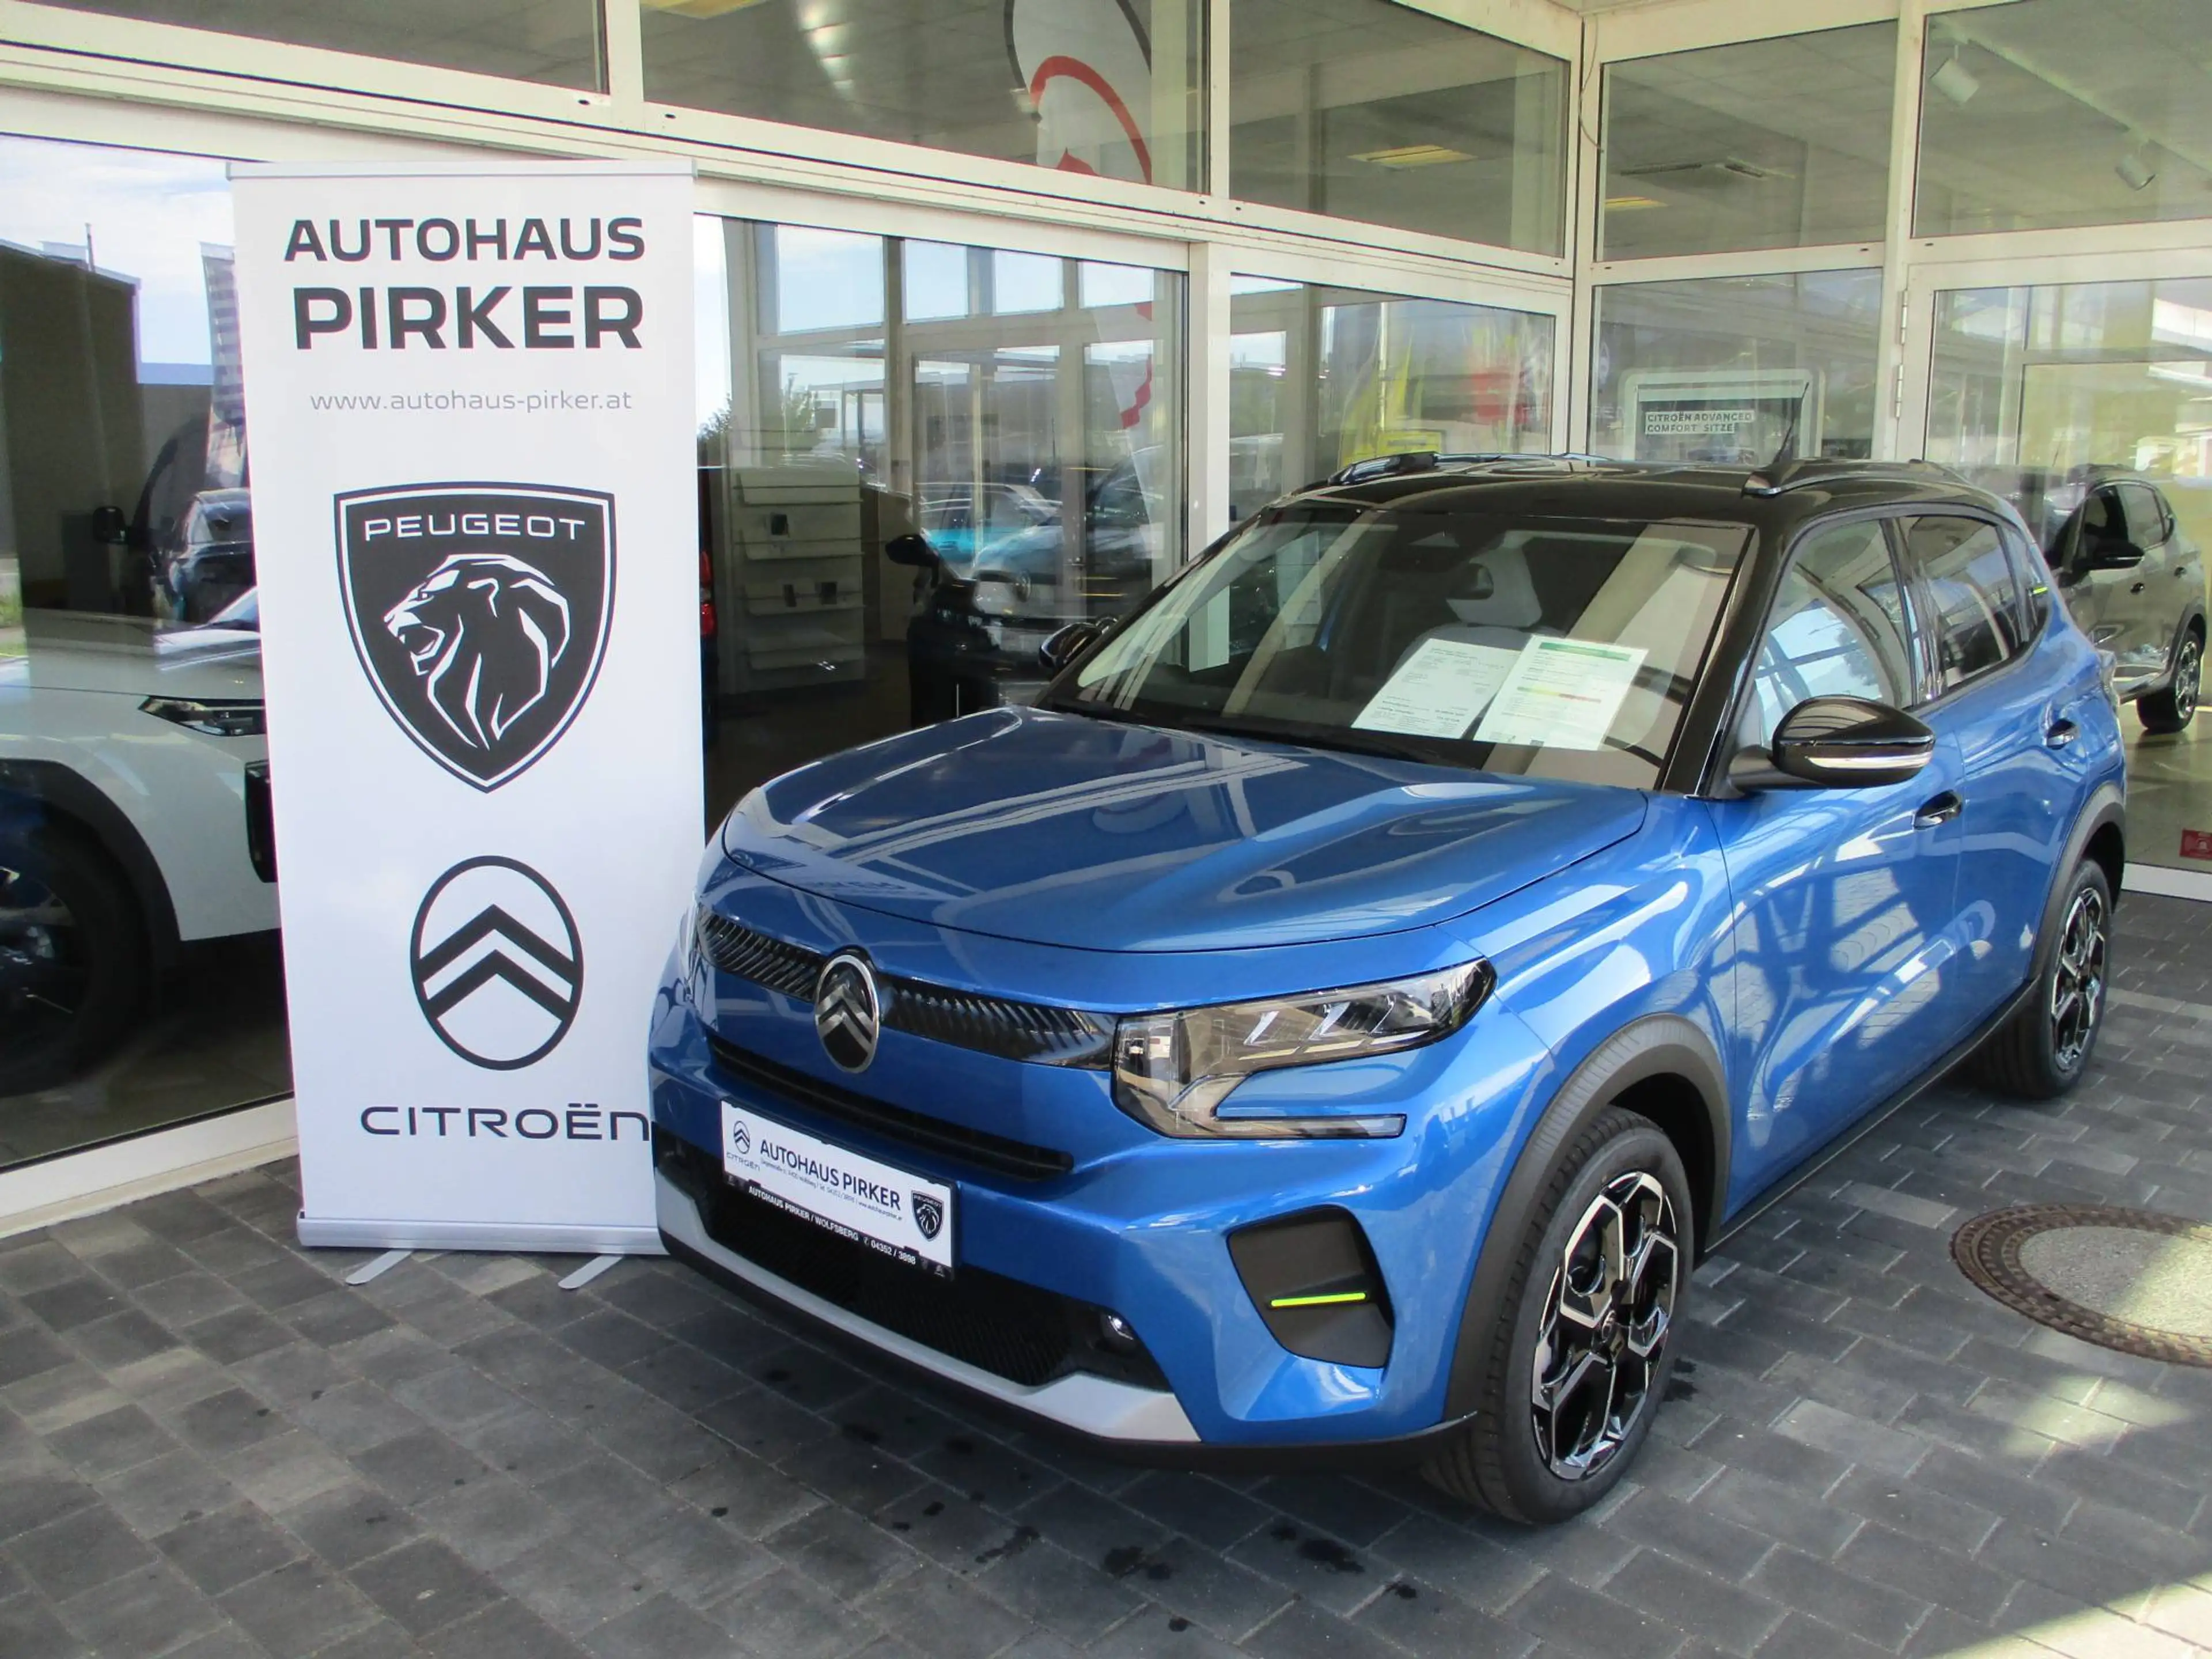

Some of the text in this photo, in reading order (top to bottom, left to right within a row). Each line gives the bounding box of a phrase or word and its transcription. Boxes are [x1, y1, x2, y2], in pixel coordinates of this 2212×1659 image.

[285, 217, 645, 262] AUTOHAUS
[293, 286, 643, 350] PIRKER
[310, 389, 632, 414] www.autohaus-pirker.at
[1694, 412, 1751, 422] ADVANCED
[1647, 424, 1698, 432] COMFORT
[364, 513, 585, 541] PEUGEOT
[361, 1103, 650, 1142] CITROËN
[760, 1139, 839, 1187] AUTOHAUS
[843, 1172, 901, 1211] PIRKER
[748, 1185, 783, 1209] AUTOHAUS
[785, 1202, 810, 1221] PIRKER
[815, 1215, 859, 1241] WOLFSBERG
